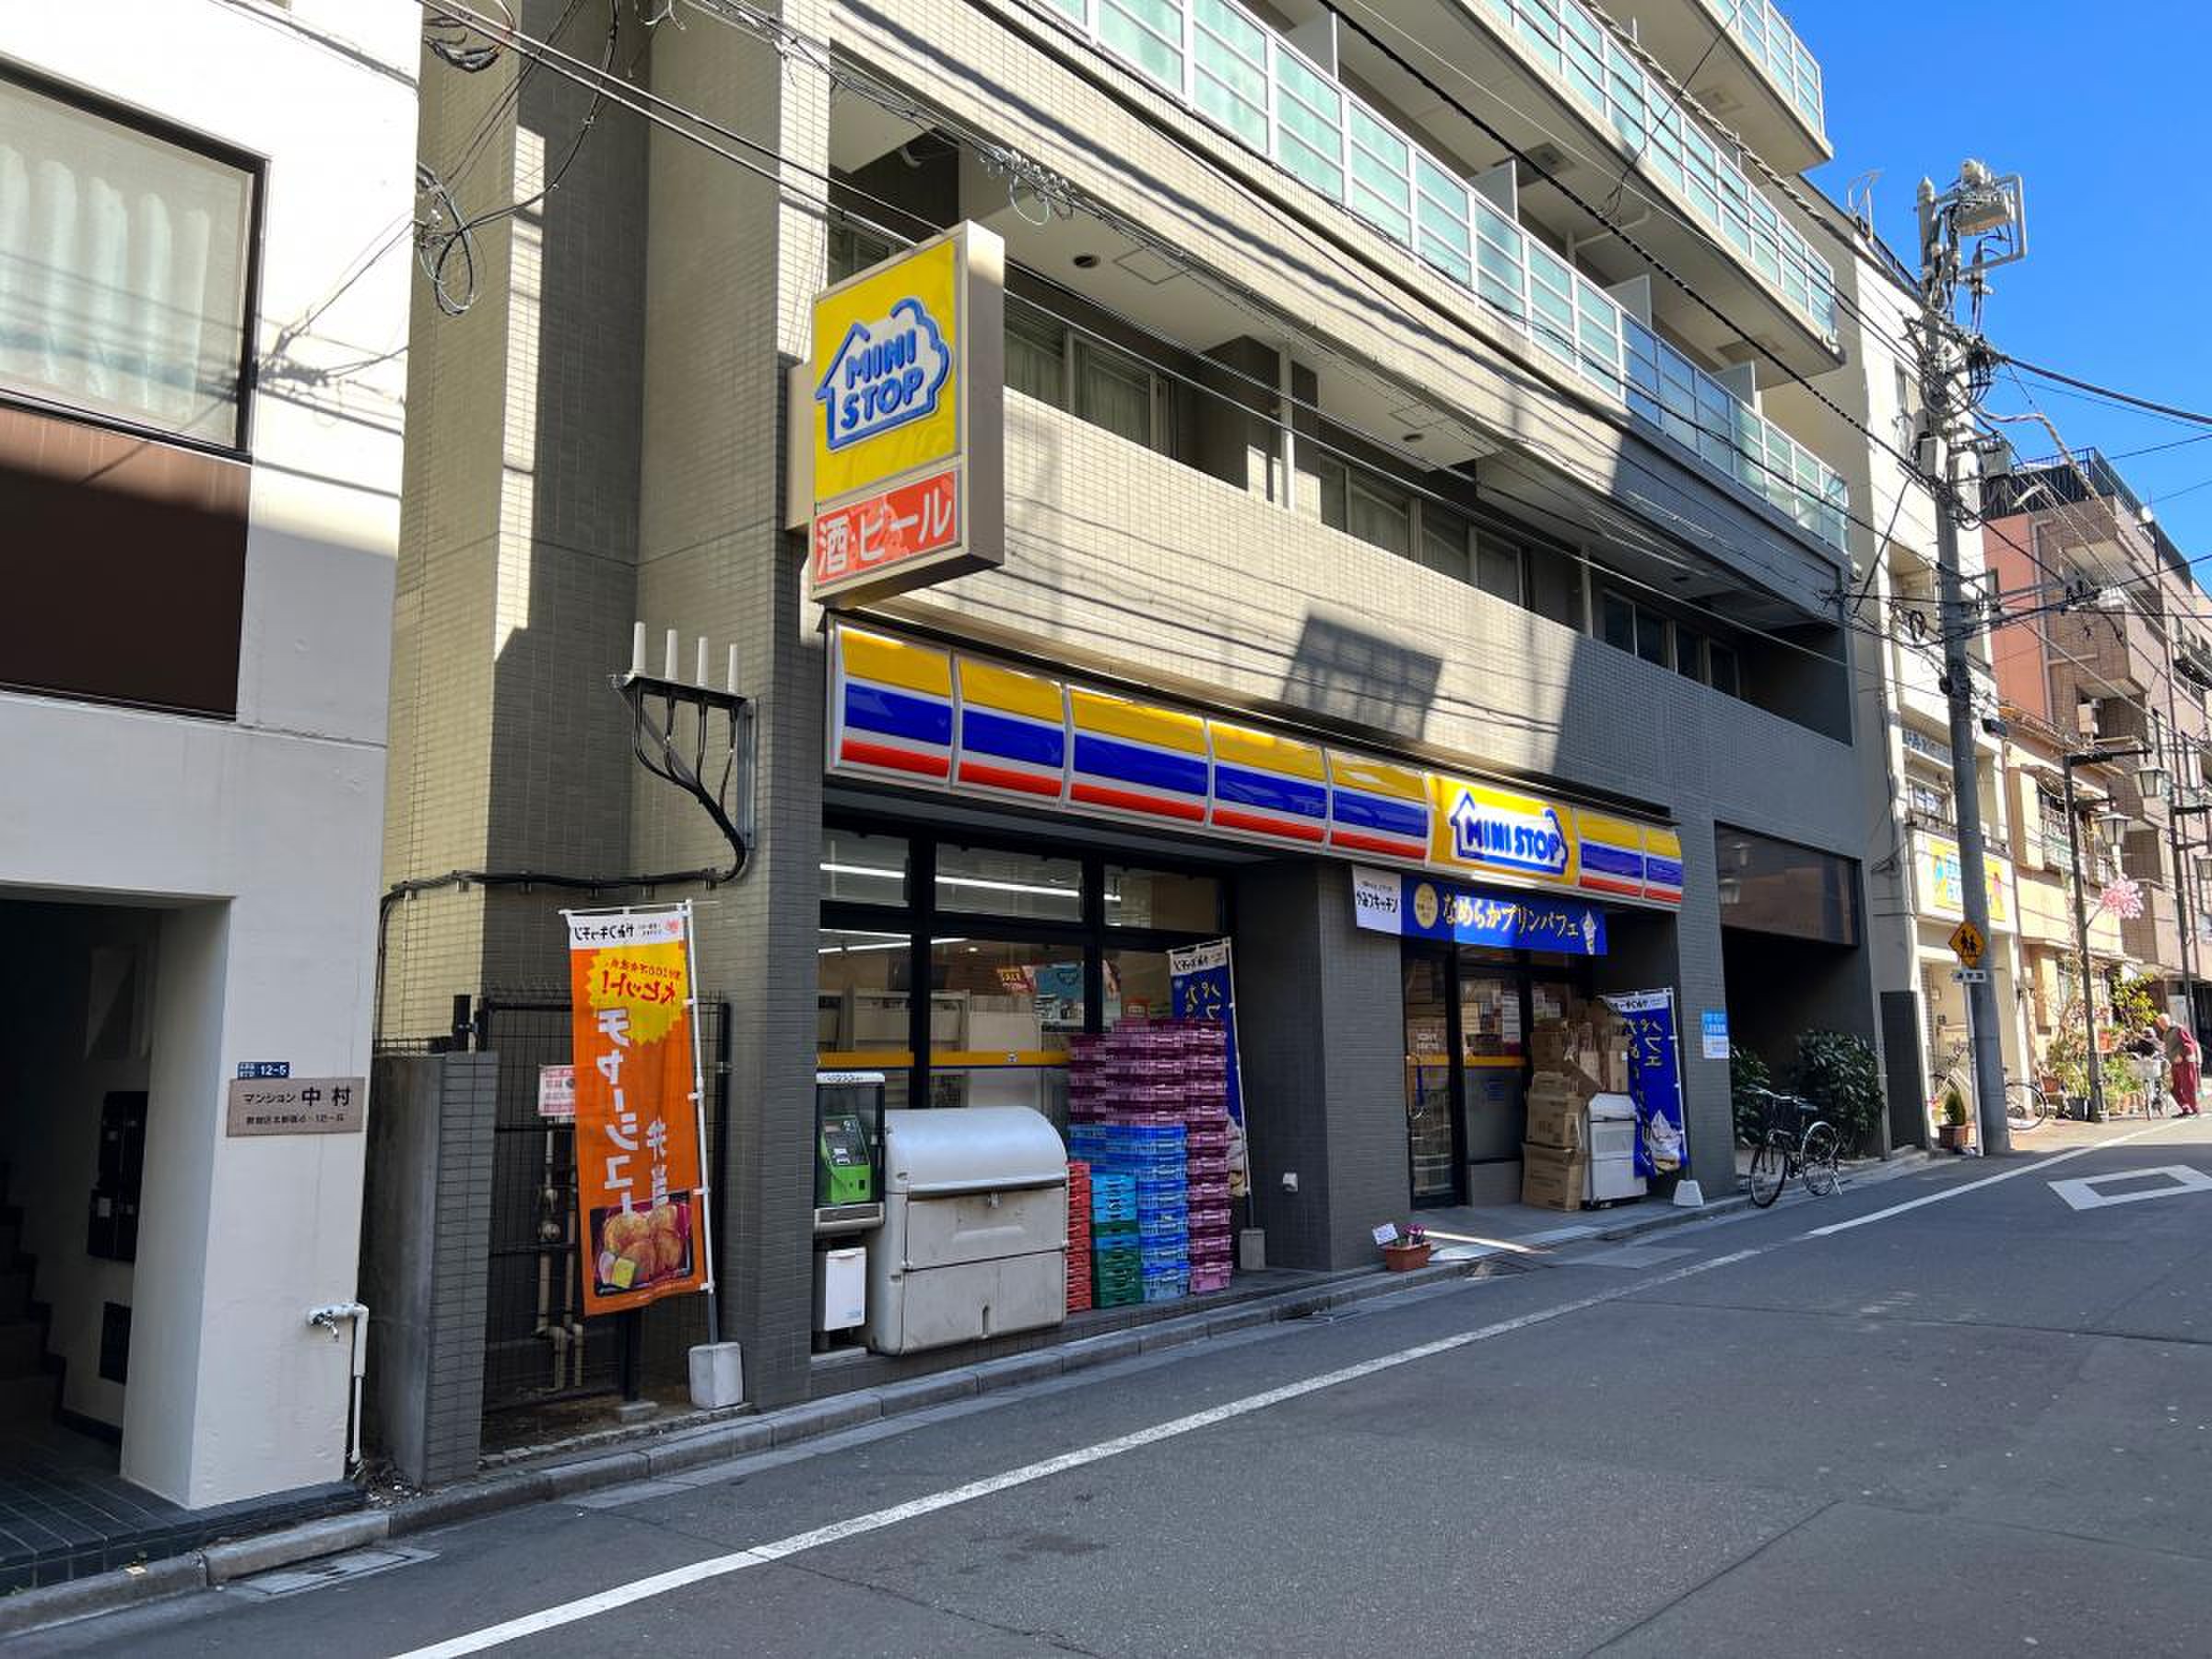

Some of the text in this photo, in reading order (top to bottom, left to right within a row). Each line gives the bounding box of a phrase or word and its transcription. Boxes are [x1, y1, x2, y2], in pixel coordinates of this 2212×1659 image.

[845, 329, 917, 388] MINI
[841, 367, 924, 430] STOP
[818, 488, 952, 574] 酒・ビール
[1465, 815, 1560, 862] MINI STOP
[1442, 892, 1580, 938] なめらかプリンパフェ
[243, 1093, 296, 1104] マンション
